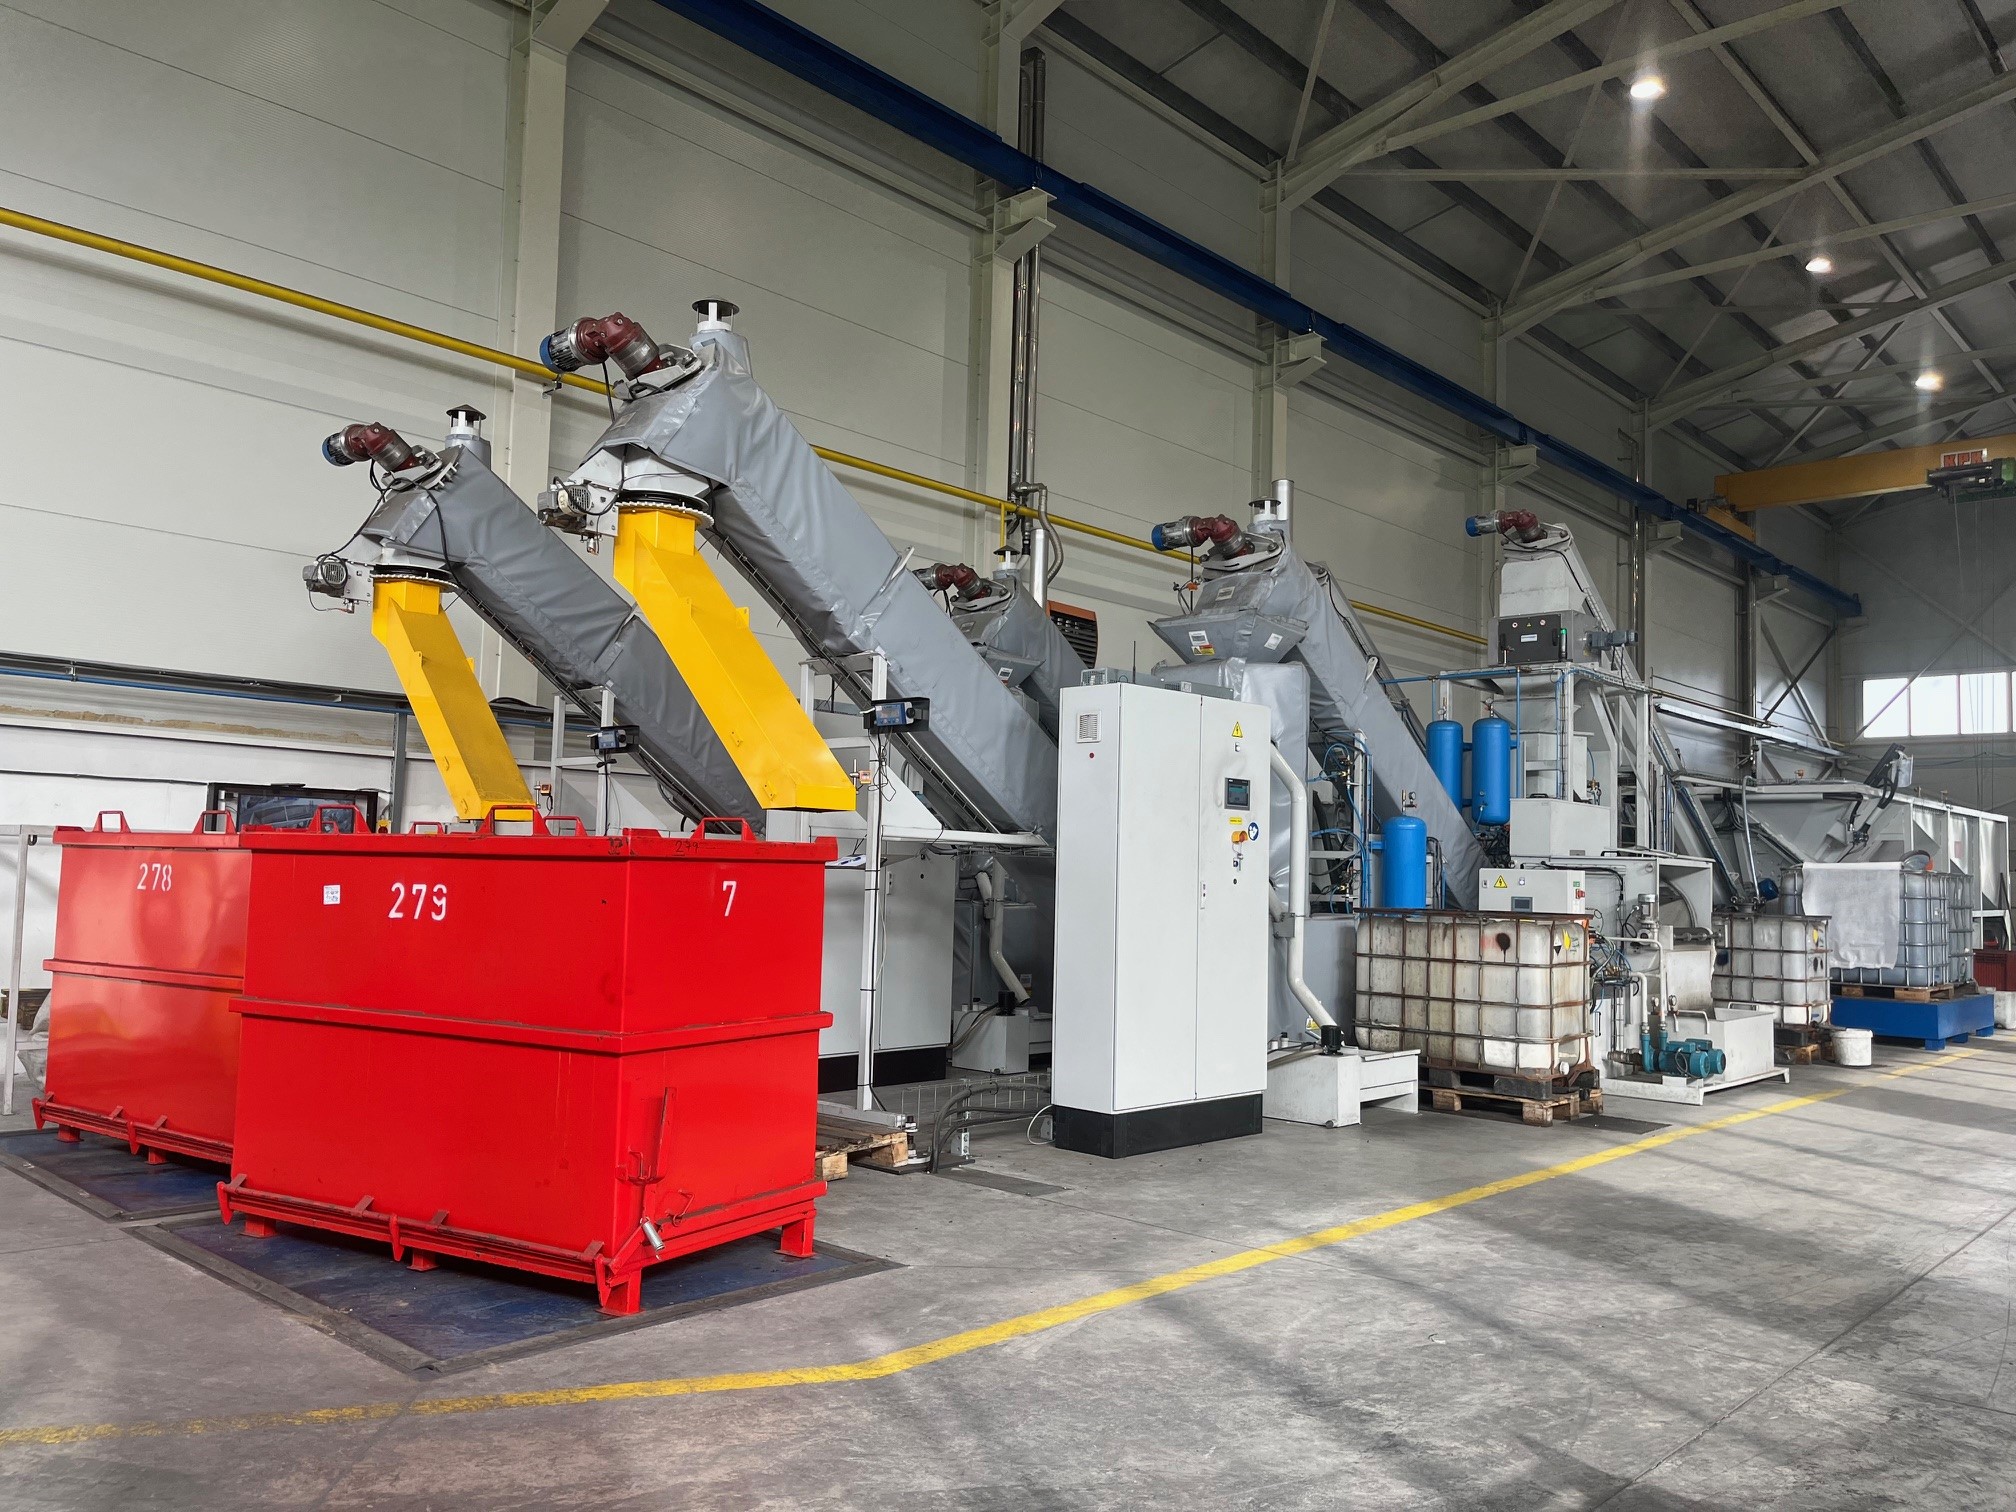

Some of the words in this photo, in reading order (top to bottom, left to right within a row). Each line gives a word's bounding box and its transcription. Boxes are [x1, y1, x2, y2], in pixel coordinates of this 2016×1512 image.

[136, 862, 173, 892] 278
[387, 881, 448, 921] 279
[722, 880, 737, 917] 7
